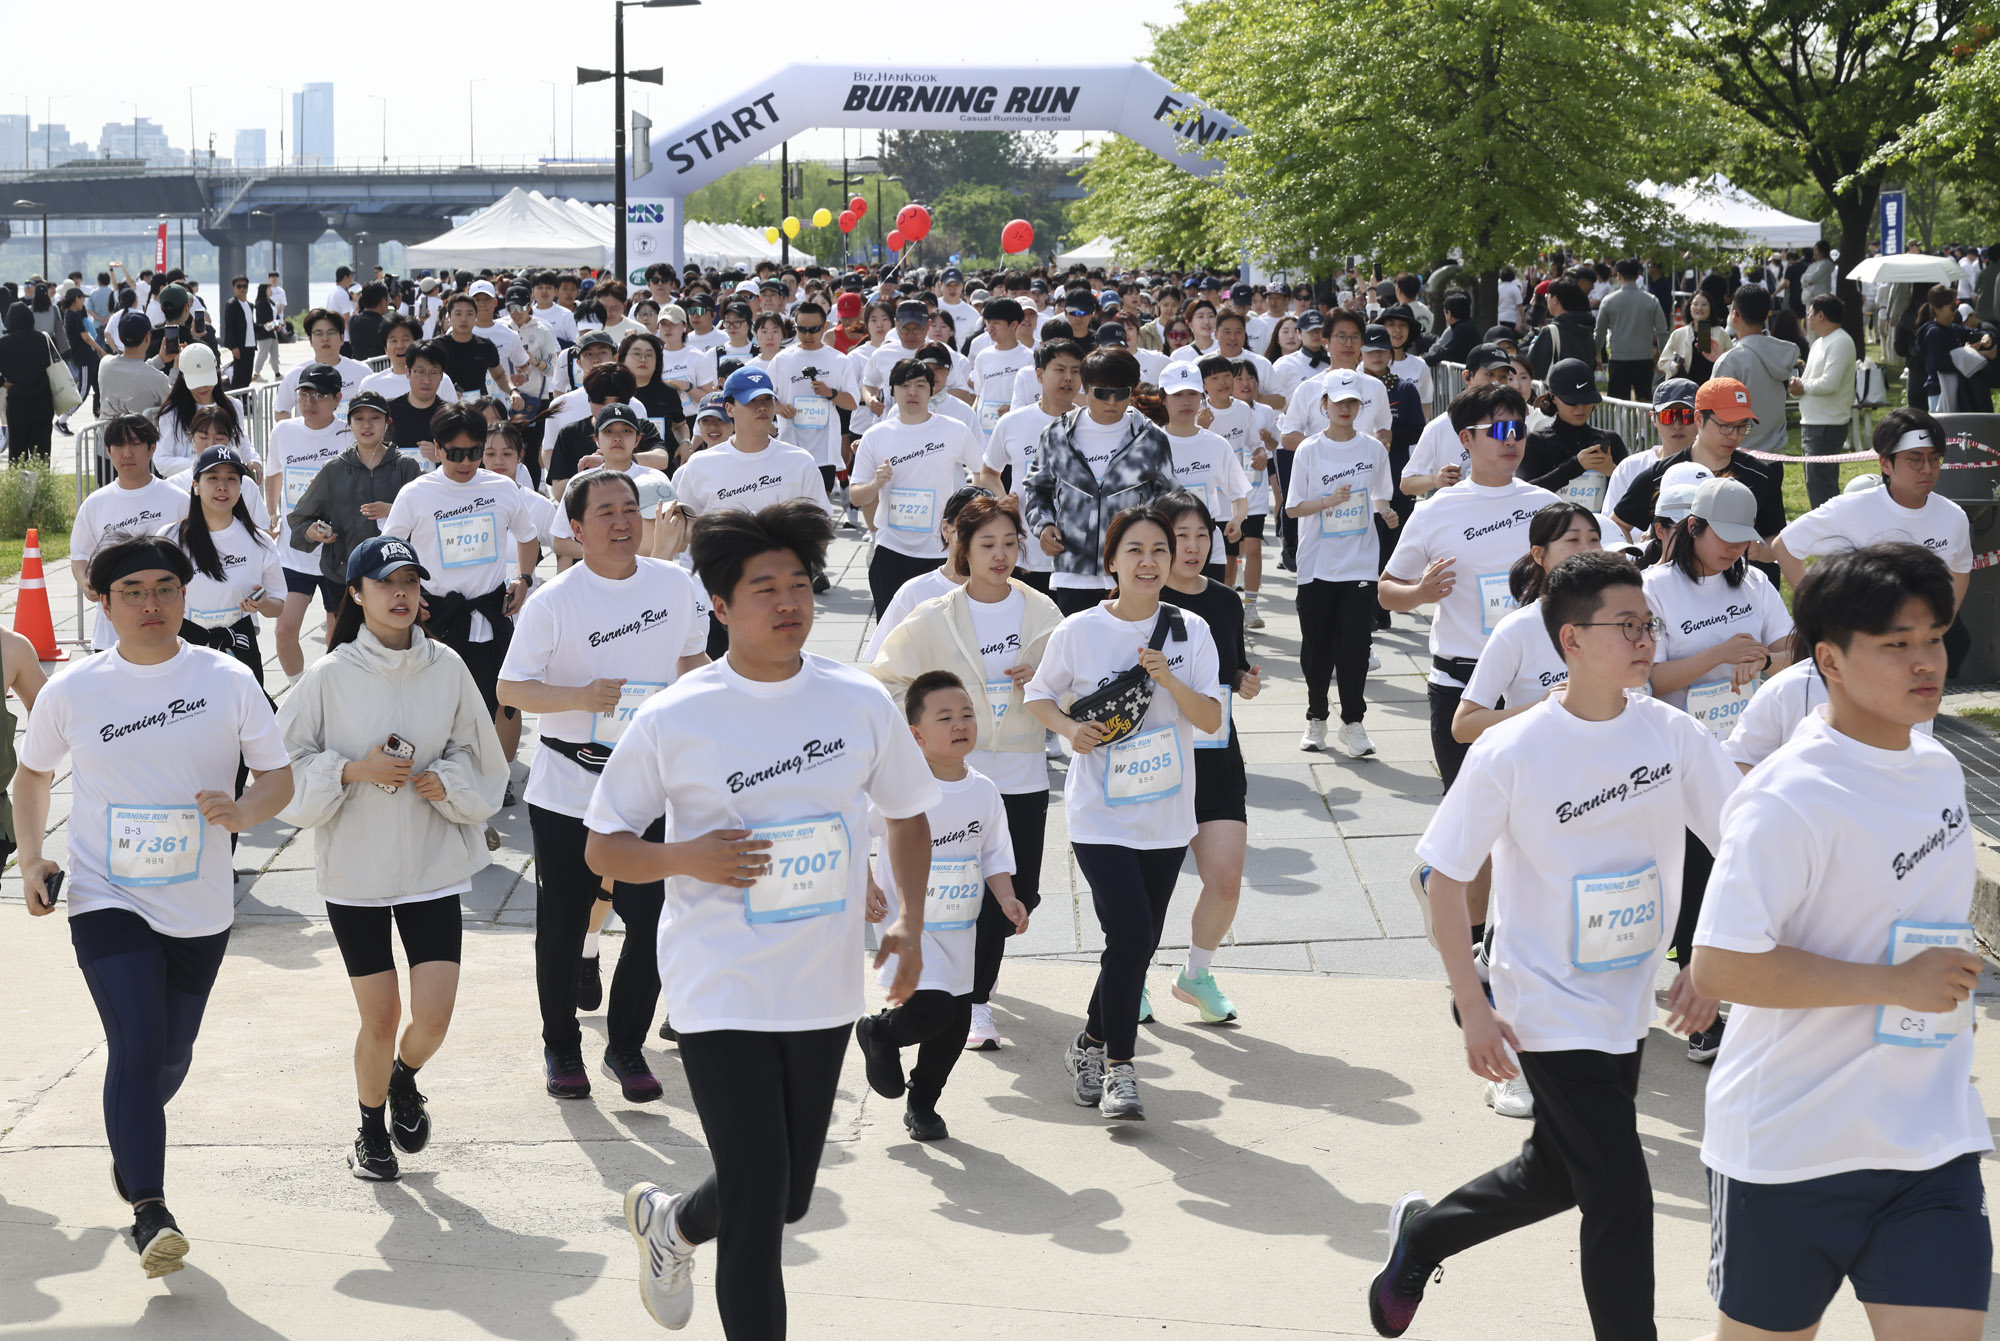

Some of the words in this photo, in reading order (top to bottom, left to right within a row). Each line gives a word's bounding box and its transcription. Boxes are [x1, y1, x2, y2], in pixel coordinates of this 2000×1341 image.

[843, 85, 998, 113] BURNING
[1003, 86, 1081, 113] RUN
[994, 115, 1032, 123] Running
[666, 92, 780, 175] START
[286, 452, 318, 465] Burning
[319, 448, 339, 458] Run
[890, 449, 925, 466] Burning
[925, 442, 945, 453] Run
[1190, 461, 1211, 471] Run
[1321, 468, 1356, 485] Burning
[1355, 462, 1373, 472] Run
[717, 481, 758, 500] Burning
[758, 475, 783, 487] Run
[1570, 487, 1601, 497] 8427
[139, 510, 163, 522] Run
[433, 504, 474, 520] Burning
[473, 497, 496, 508] Run
[898, 504, 929, 515] 7272
[1325, 510, 1334, 518] W
[1335, 505, 1364, 519] 8467
[1463, 518, 1513, 540] Burning
[446, 538, 455, 546] M
[456, 532, 489, 546] 7010
[223, 554, 248, 567] Run
[1490, 598, 1500, 607] M
[1680, 613, 1728, 635] Burning
[1726, 603, 1753, 619] Run
[588, 620, 642, 648] Burning
[641, 608, 669, 626] Run
[100, 711, 168, 743] Burning
[167, 698, 208, 719] Run
[1694, 710, 1706, 720] W
[1121, 719, 1132, 735] SB
[726, 755, 804, 794] Burning
[802, 738, 846, 763] Run
[1114, 764, 1127, 774] W
[1127, 751, 1172, 776] 8035
[1555, 783, 1630, 824] Burning
[1629, 762, 1674, 791] Run
[116, 811, 151, 820] BURNING
[151, 812, 170, 820] RUN
[124, 826, 142, 836] B-3
[753, 829, 795, 841] BURNING
[796, 826, 816, 837] RUN
[118, 838, 131, 849] M
[135, 835, 189, 853] 7361
[1892, 827, 1946, 881] Burning
[1941, 804, 1965, 830] Run
[779, 849, 843, 878] 7007
[938, 883, 980, 900] 7022
[1584, 882, 1625, 893] BURNING
[1588, 914, 1604, 929] M
[1607, 900, 1656, 930] 7023
[1900, 1016, 1927, 1033] C-3
